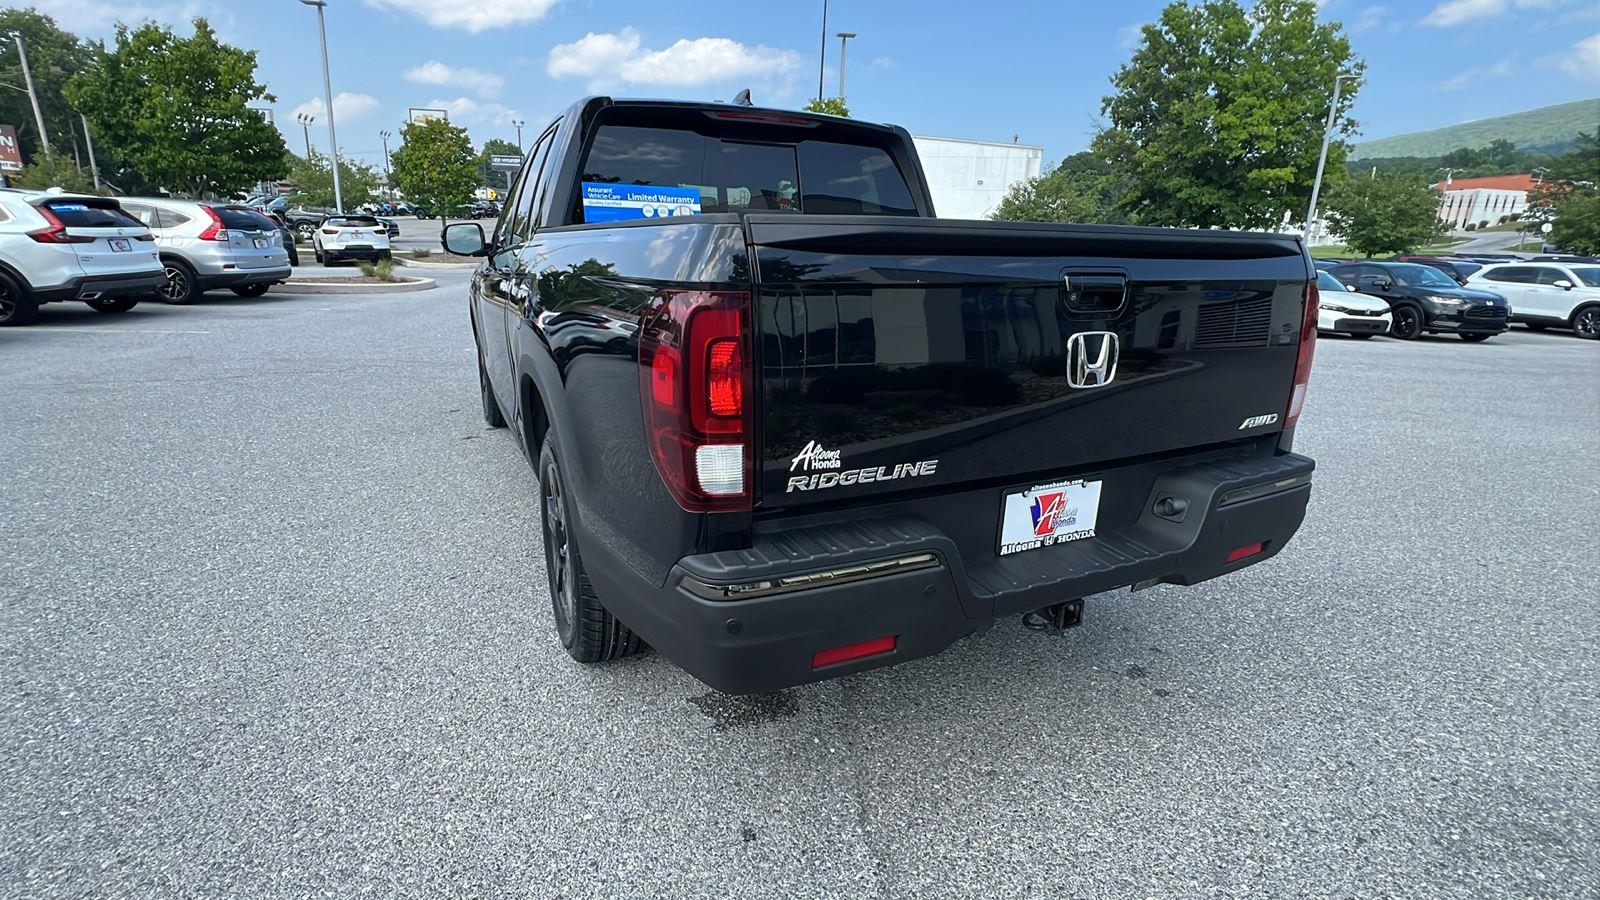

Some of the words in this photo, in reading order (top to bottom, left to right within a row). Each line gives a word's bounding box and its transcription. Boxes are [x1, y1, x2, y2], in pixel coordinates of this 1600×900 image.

[588, 192, 608, 200] Vehicle
[627, 192, 657, 202] Limited
[658, 194, 695, 204] Warranty
[1238, 413, 1278, 430] AWD
[790, 440, 840, 471] Altoona
[811, 459, 841, 470] Honda
[786, 459, 939, 493] RIDGELINE
[1052, 516, 1077, 527] Honda
[1000, 540, 1042, 555] Altoona
[1057, 530, 1095, 544] HONDA
